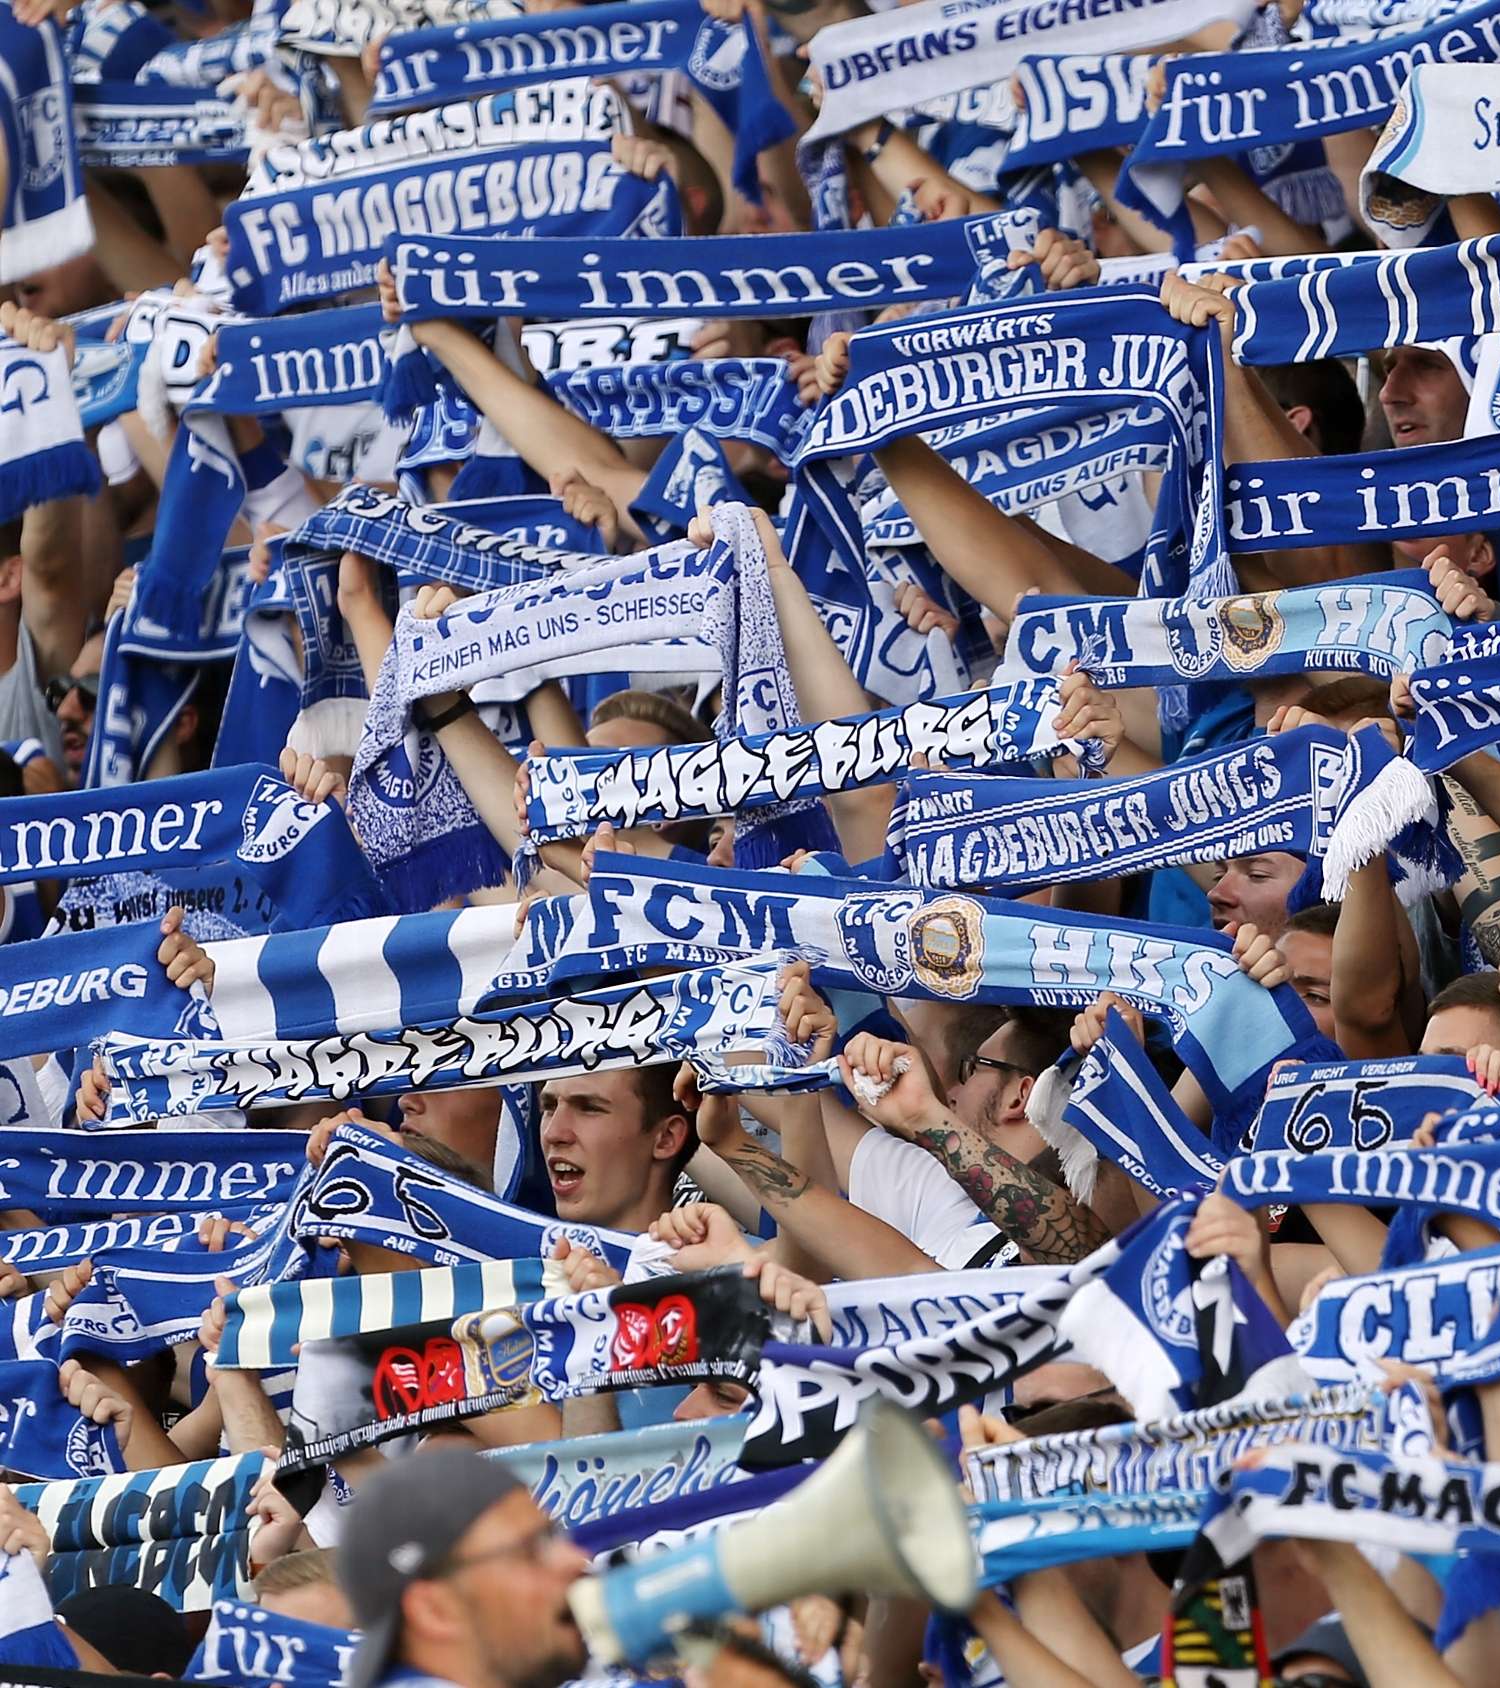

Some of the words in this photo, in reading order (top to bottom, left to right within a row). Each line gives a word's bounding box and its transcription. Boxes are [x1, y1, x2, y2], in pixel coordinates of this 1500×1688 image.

[455, 18, 678, 83] immer
[1155, 71, 1267, 148] für
[239, 202, 310, 276] FC
[312, 151, 623, 259] MAGDEBURG
[395, 242, 540, 313] für
[577, 253, 935, 310] immer
[892, 312, 1056, 357] VORWÄRTS
[249, 336, 384, 402] imm
[1015, 475, 1066, 506] UNS
[410, 644, 483, 685] KEINER
[487, 625, 531, 658] MAG
[535, 614, 578, 642] UNS
[1303, 650, 1361, 670] HUTNIK
[589, 692, 997, 829] MAGDEBURG
[8, 798, 223, 872] mmer
[905, 790, 1158, 888] MAGDEBURGER
[1165, 744, 1282, 833] JUNGS
[1256, 821, 1294, 847] UNS
[588, 877, 800, 951] FCM
[1028, 924, 1244, 1015] HKS
[213, 988, 667, 1109] MAGDEBURG
[1310, 1065, 1348, 1082] NICHT
[1360, 1060, 1418, 1078] VERLOREN
[335, 1124, 386, 1150] NICHT
[1284, 1080, 1396, 1154] 65
[39, 1147, 296, 1201] immer
[4, 1210, 224, 1264] mmer
[297, 1223, 358, 1241] SSTEN
[381, 1233, 419, 1255] AUF
[433, 1249, 462, 1268] DER
[1282, 1462, 1362, 1510] FC
[194, 1600, 306, 1682] für
